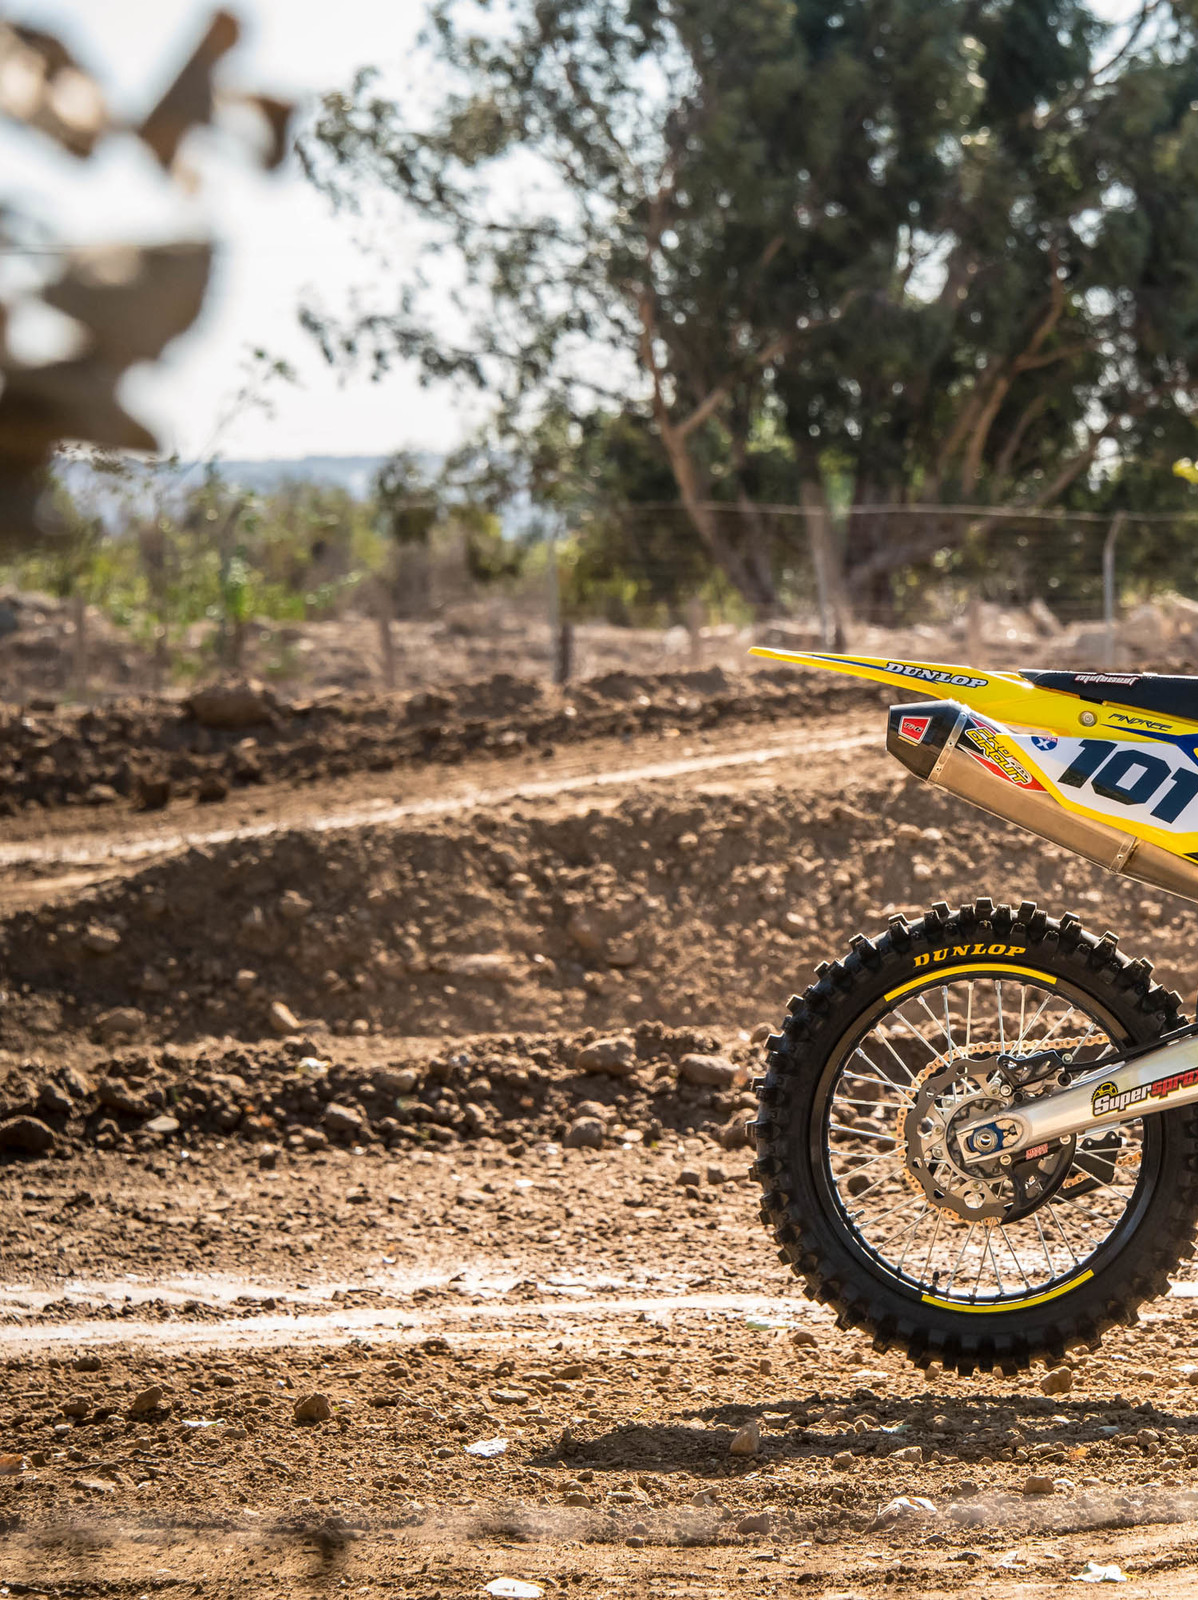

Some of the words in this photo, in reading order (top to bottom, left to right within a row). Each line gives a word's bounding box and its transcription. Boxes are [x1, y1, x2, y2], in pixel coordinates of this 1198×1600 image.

[884, 662, 988, 688] DUNLOP
[1108, 713, 1173, 732] PINDREE
[965, 729, 1029, 784] CIRCUIT
[912, 943, 1026, 969] DUNLOP
